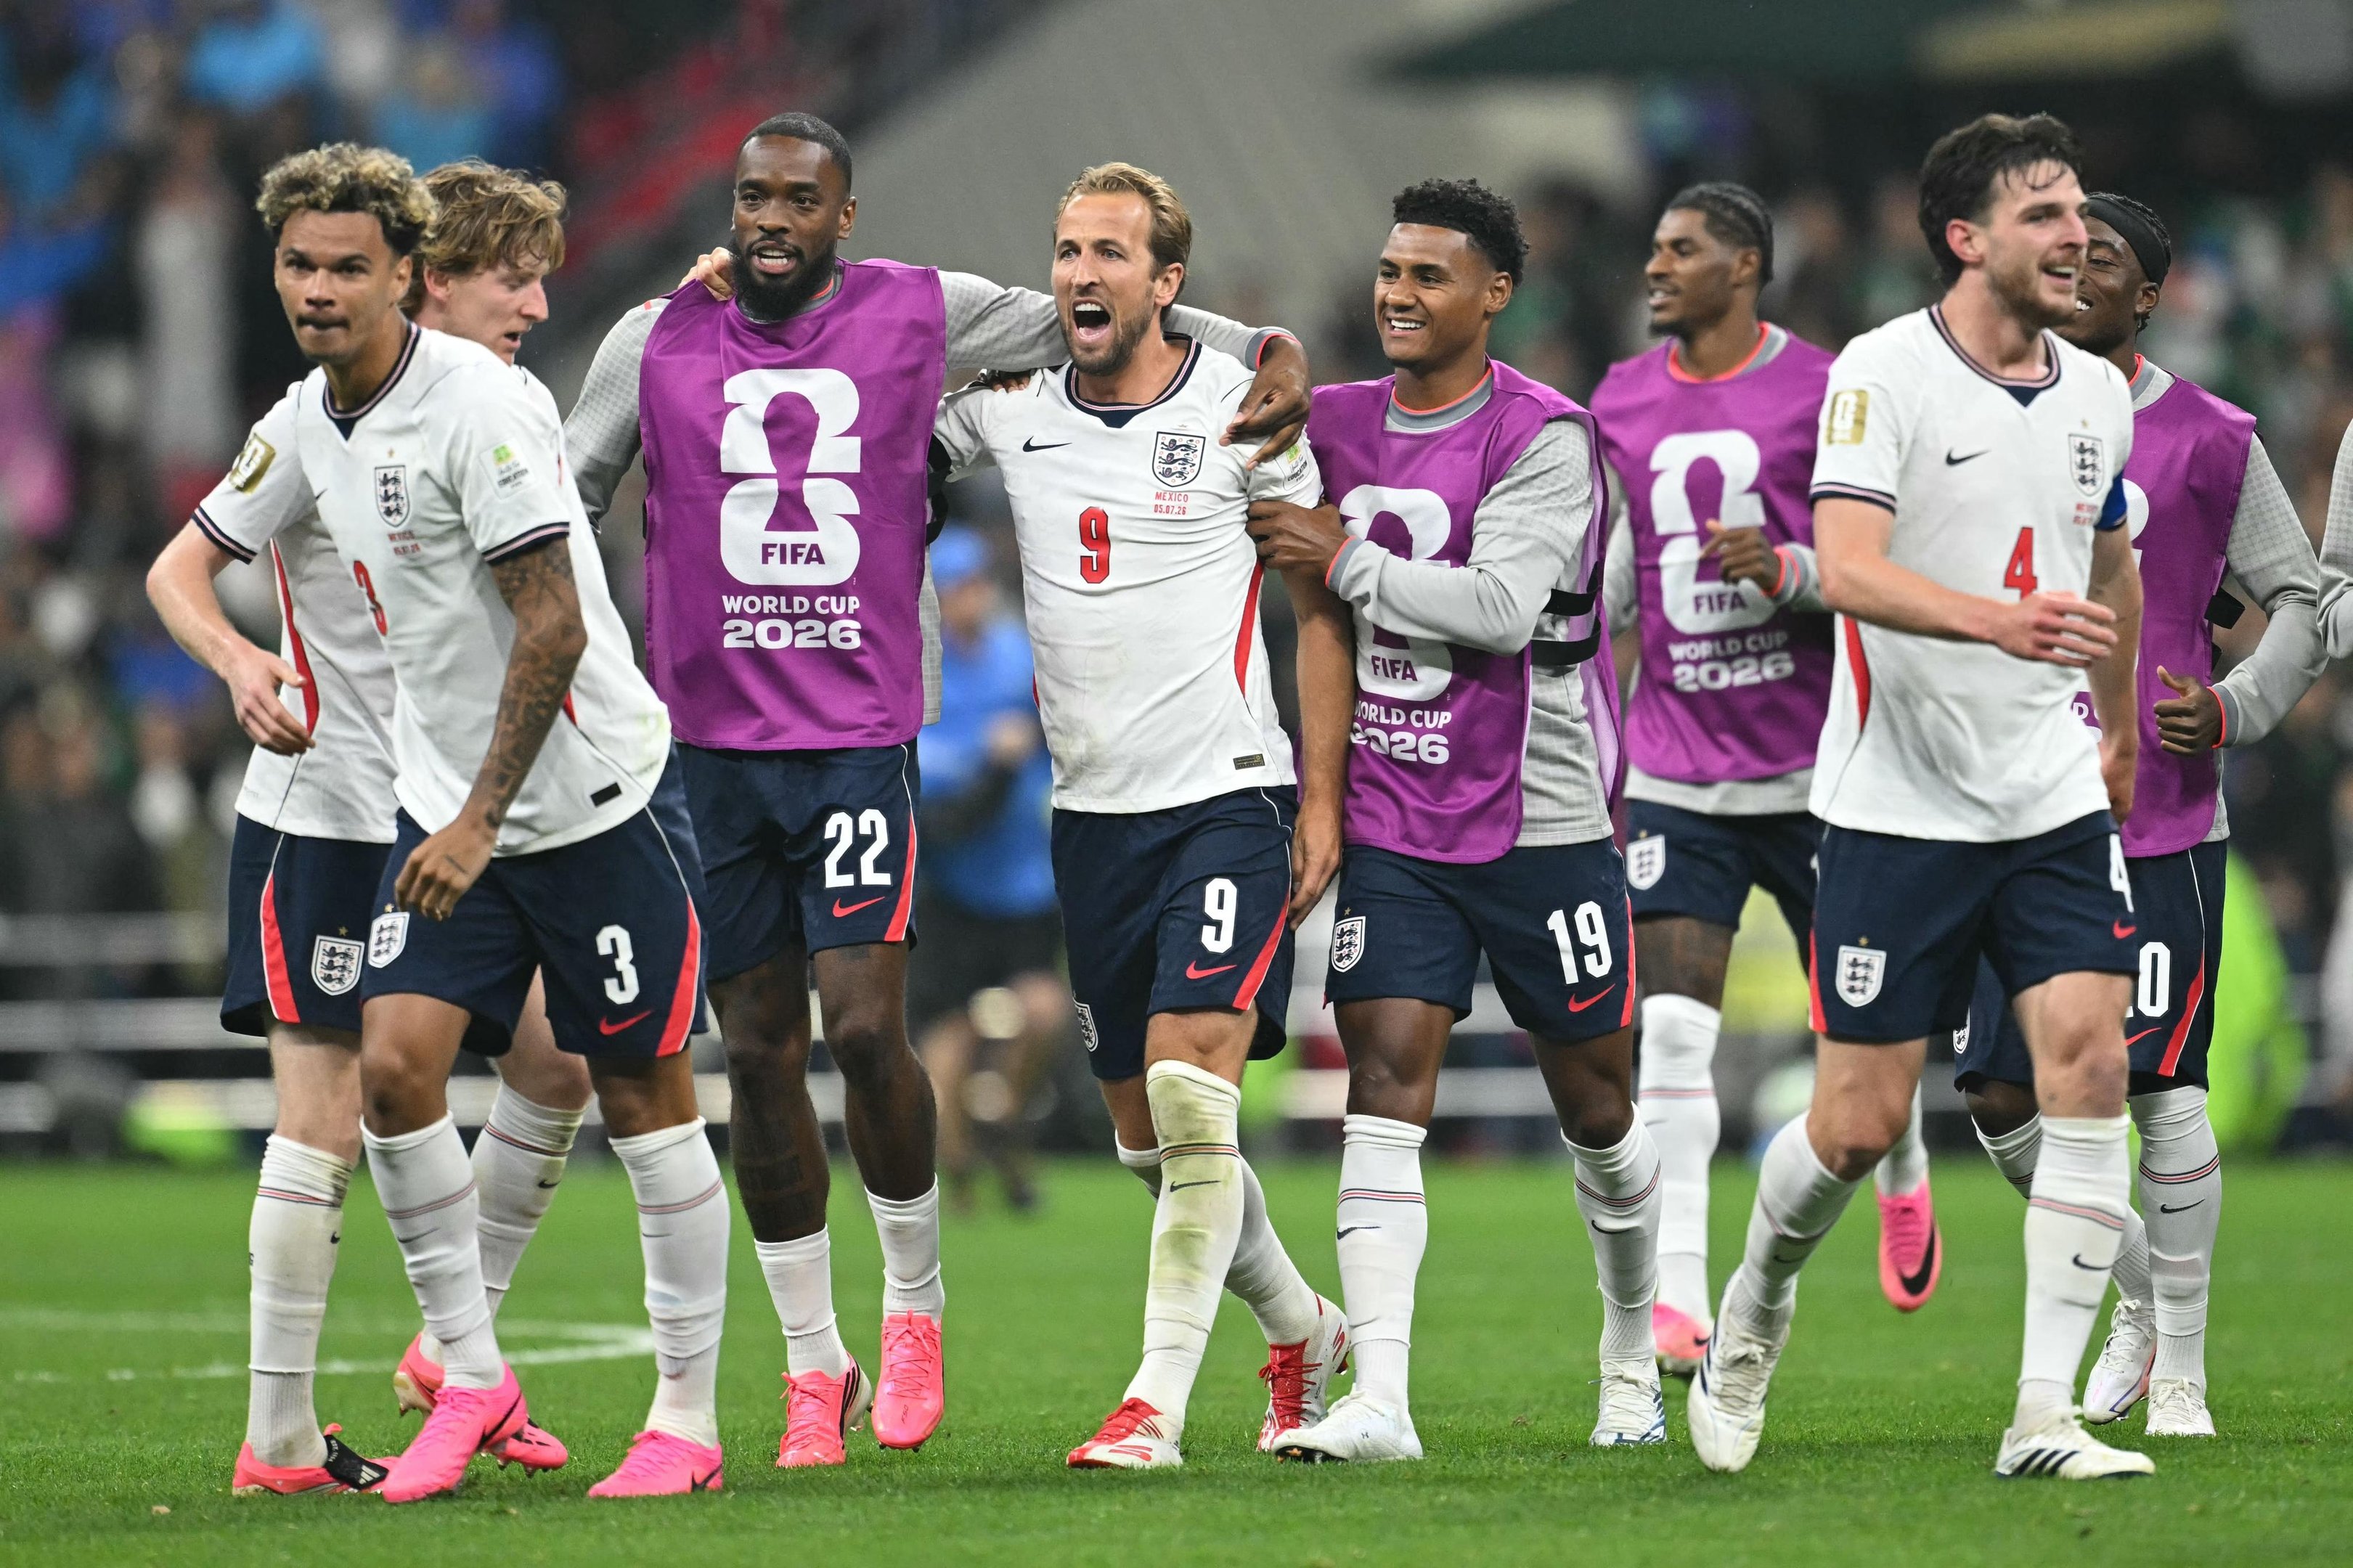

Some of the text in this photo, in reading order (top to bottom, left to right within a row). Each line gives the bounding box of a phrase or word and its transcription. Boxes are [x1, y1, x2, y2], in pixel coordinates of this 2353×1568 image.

[1154, 491, 1188, 502] MEXICO
[1154, 504, 1187, 515] 05.07.26
[762, 543, 825, 565] FIFA
[1079, 507, 1111, 584] 9
[2004, 526, 2038, 601] 4
[722, 595, 860, 615] WORLD CUP
[1694, 591, 1748, 615] FIFA
[722, 618, 862, 650] 2026
[1668, 630, 1788, 662] WORLD CUP
[1371, 655, 1419, 682] FIFA
[1672, 651, 1795, 693] 2026
[1409, 709, 1452, 729] CUP
[1350, 722, 1450, 765] 2026
[824, 808, 892, 889] 22
[2109, 833, 2134, 913] 4
[1201, 878, 1238, 954] 9
[1546, 900, 1612, 985] 19
[596, 924, 640, 1005] 3
[2125, 942, 2171, 1018] 0
[900, 1403, 910, 1424] F50
